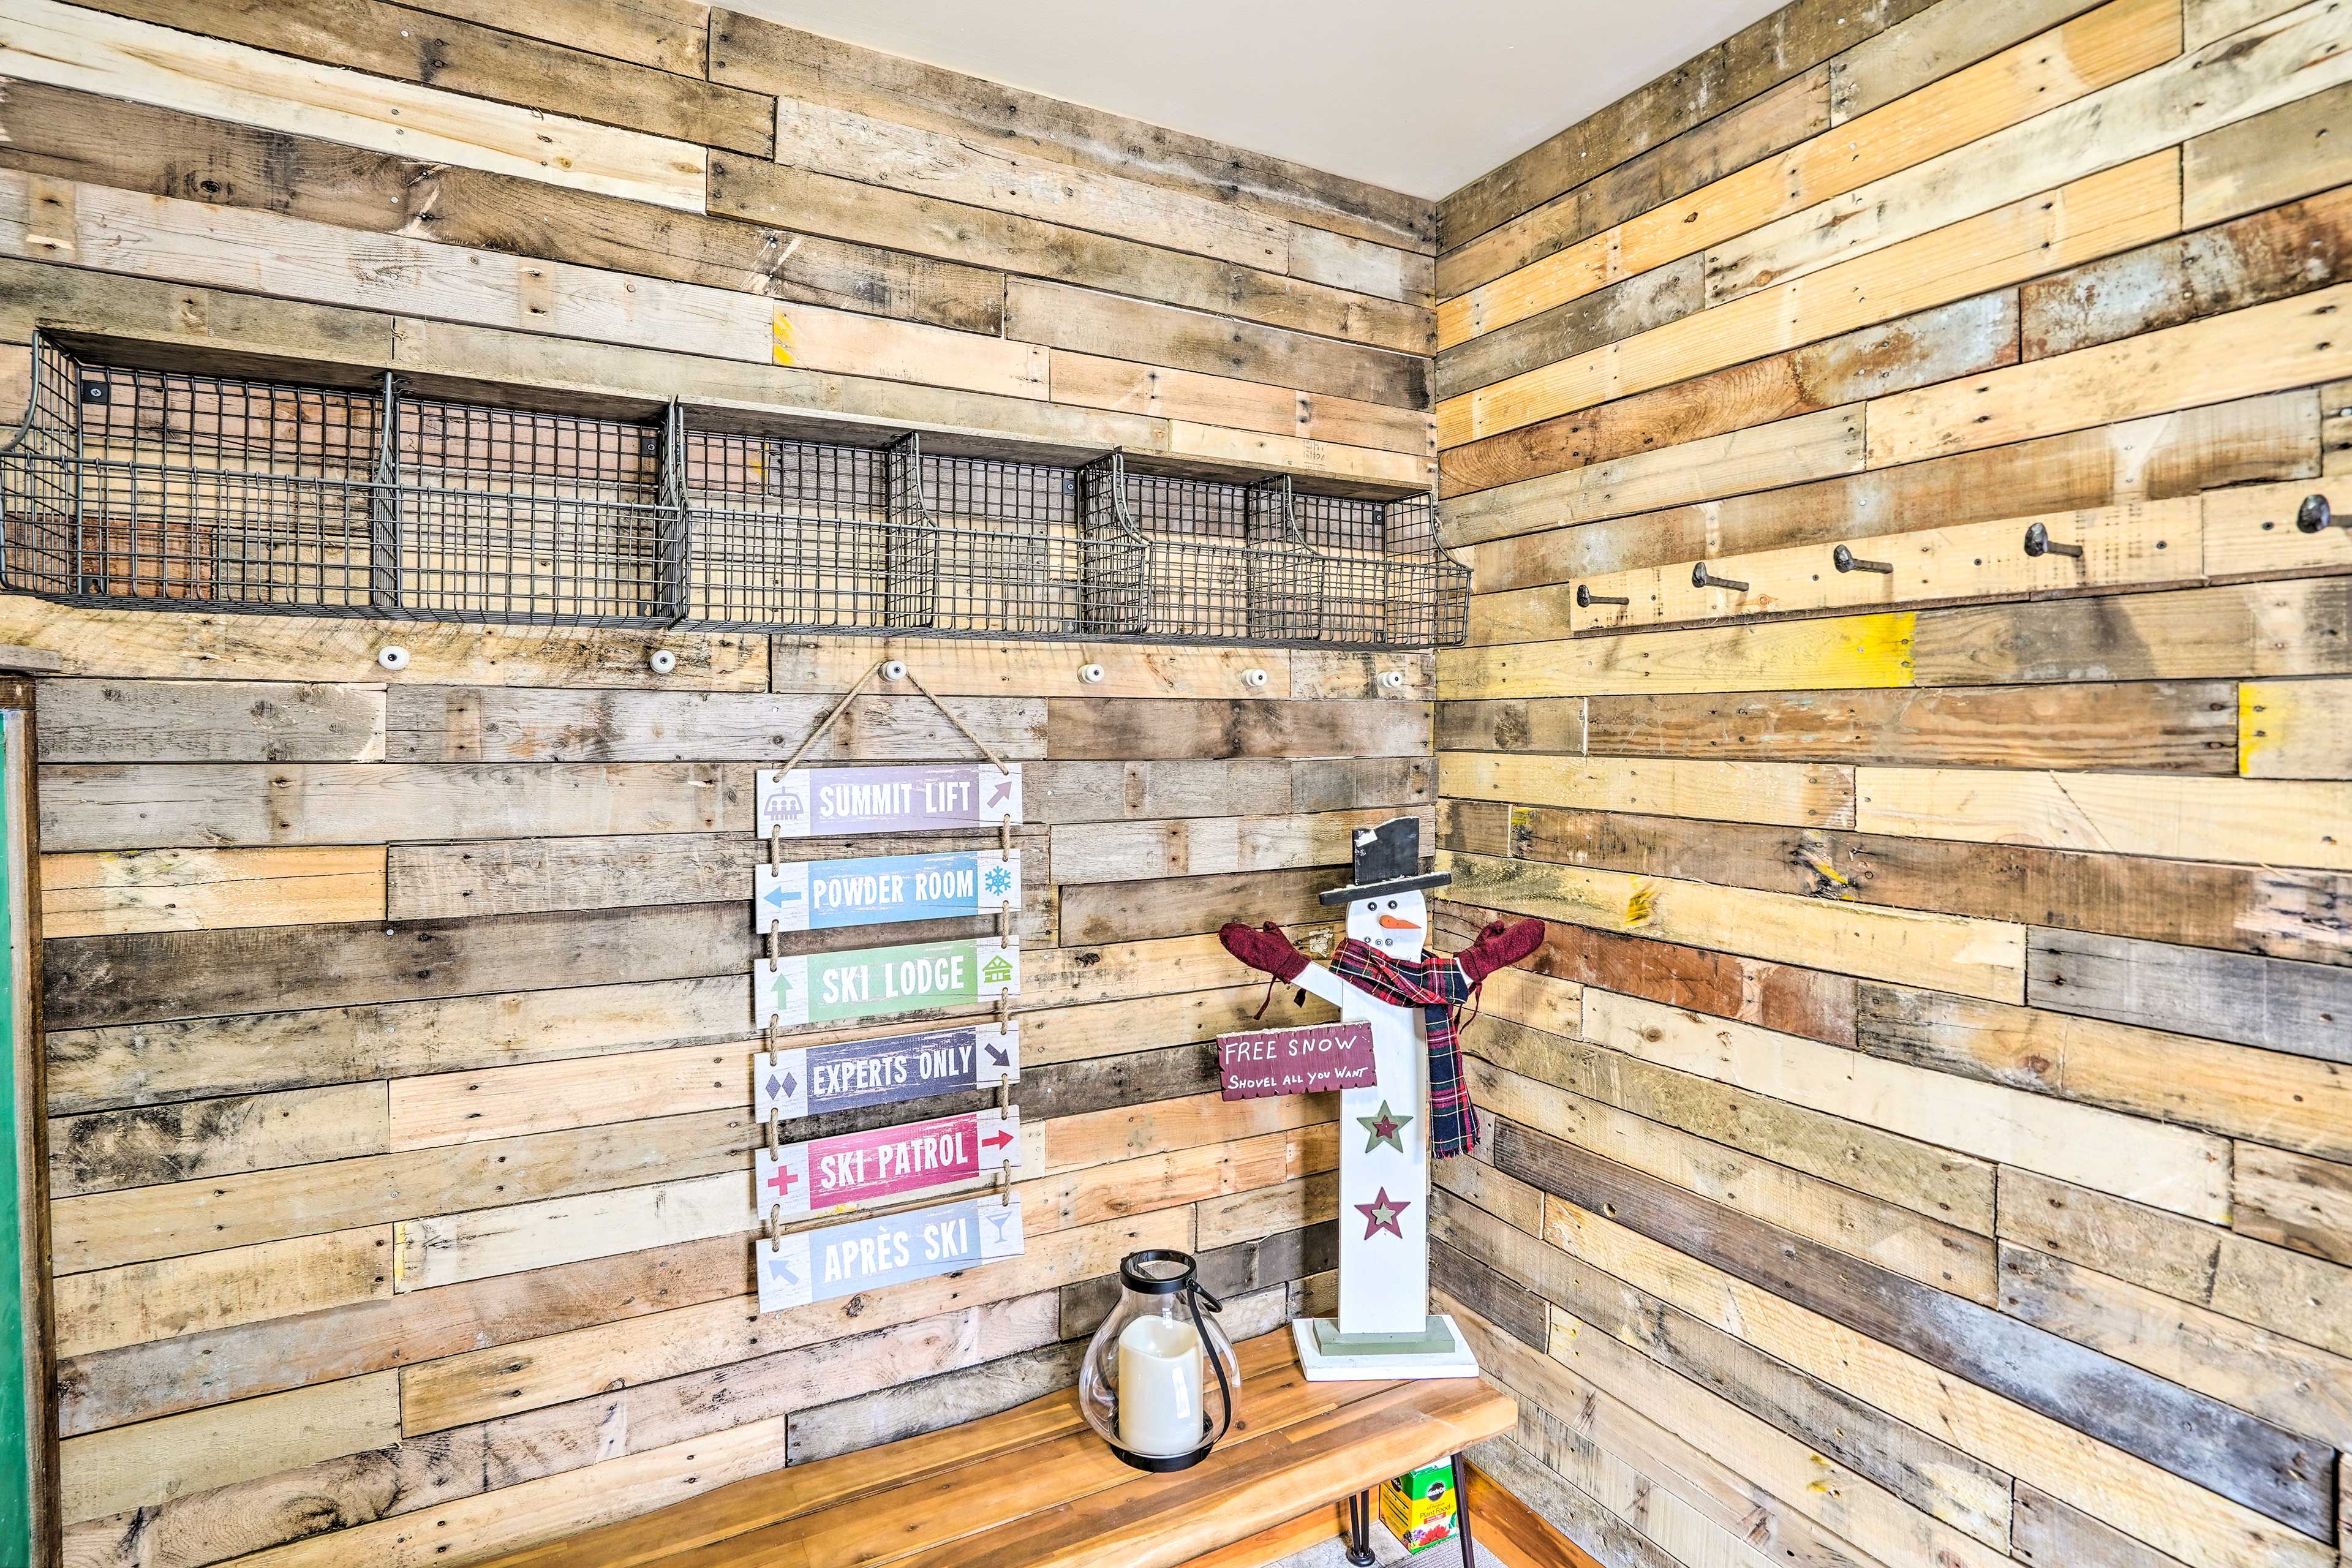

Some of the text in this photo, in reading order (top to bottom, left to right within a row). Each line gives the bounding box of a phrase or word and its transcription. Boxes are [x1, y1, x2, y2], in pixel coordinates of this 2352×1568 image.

[820, 781, 971, 818] SUMMIT LIFT
[813, 870, 974, 909] POWDER ROOM
[823, 955, 965, 1004] SKI LODGE
[1225, 1035, 1357, 1065] FREE SNOW
[813, 1046, 973, 1095] EXPERTS ONLY
[1227, 1074, 1277, 1089] SHOVEL
[1283, 1074, 1303, 1085] ALL
[1334, 1066, 1369, 1079] WANT
[820, 1133, 968, 1189] SKI PATROL
[824, 1218, 968, 1283] APRÈS SKI
[1420, 1510, 1435, 1519] Plant
[1436, 1502, 1450, 1514] Food
